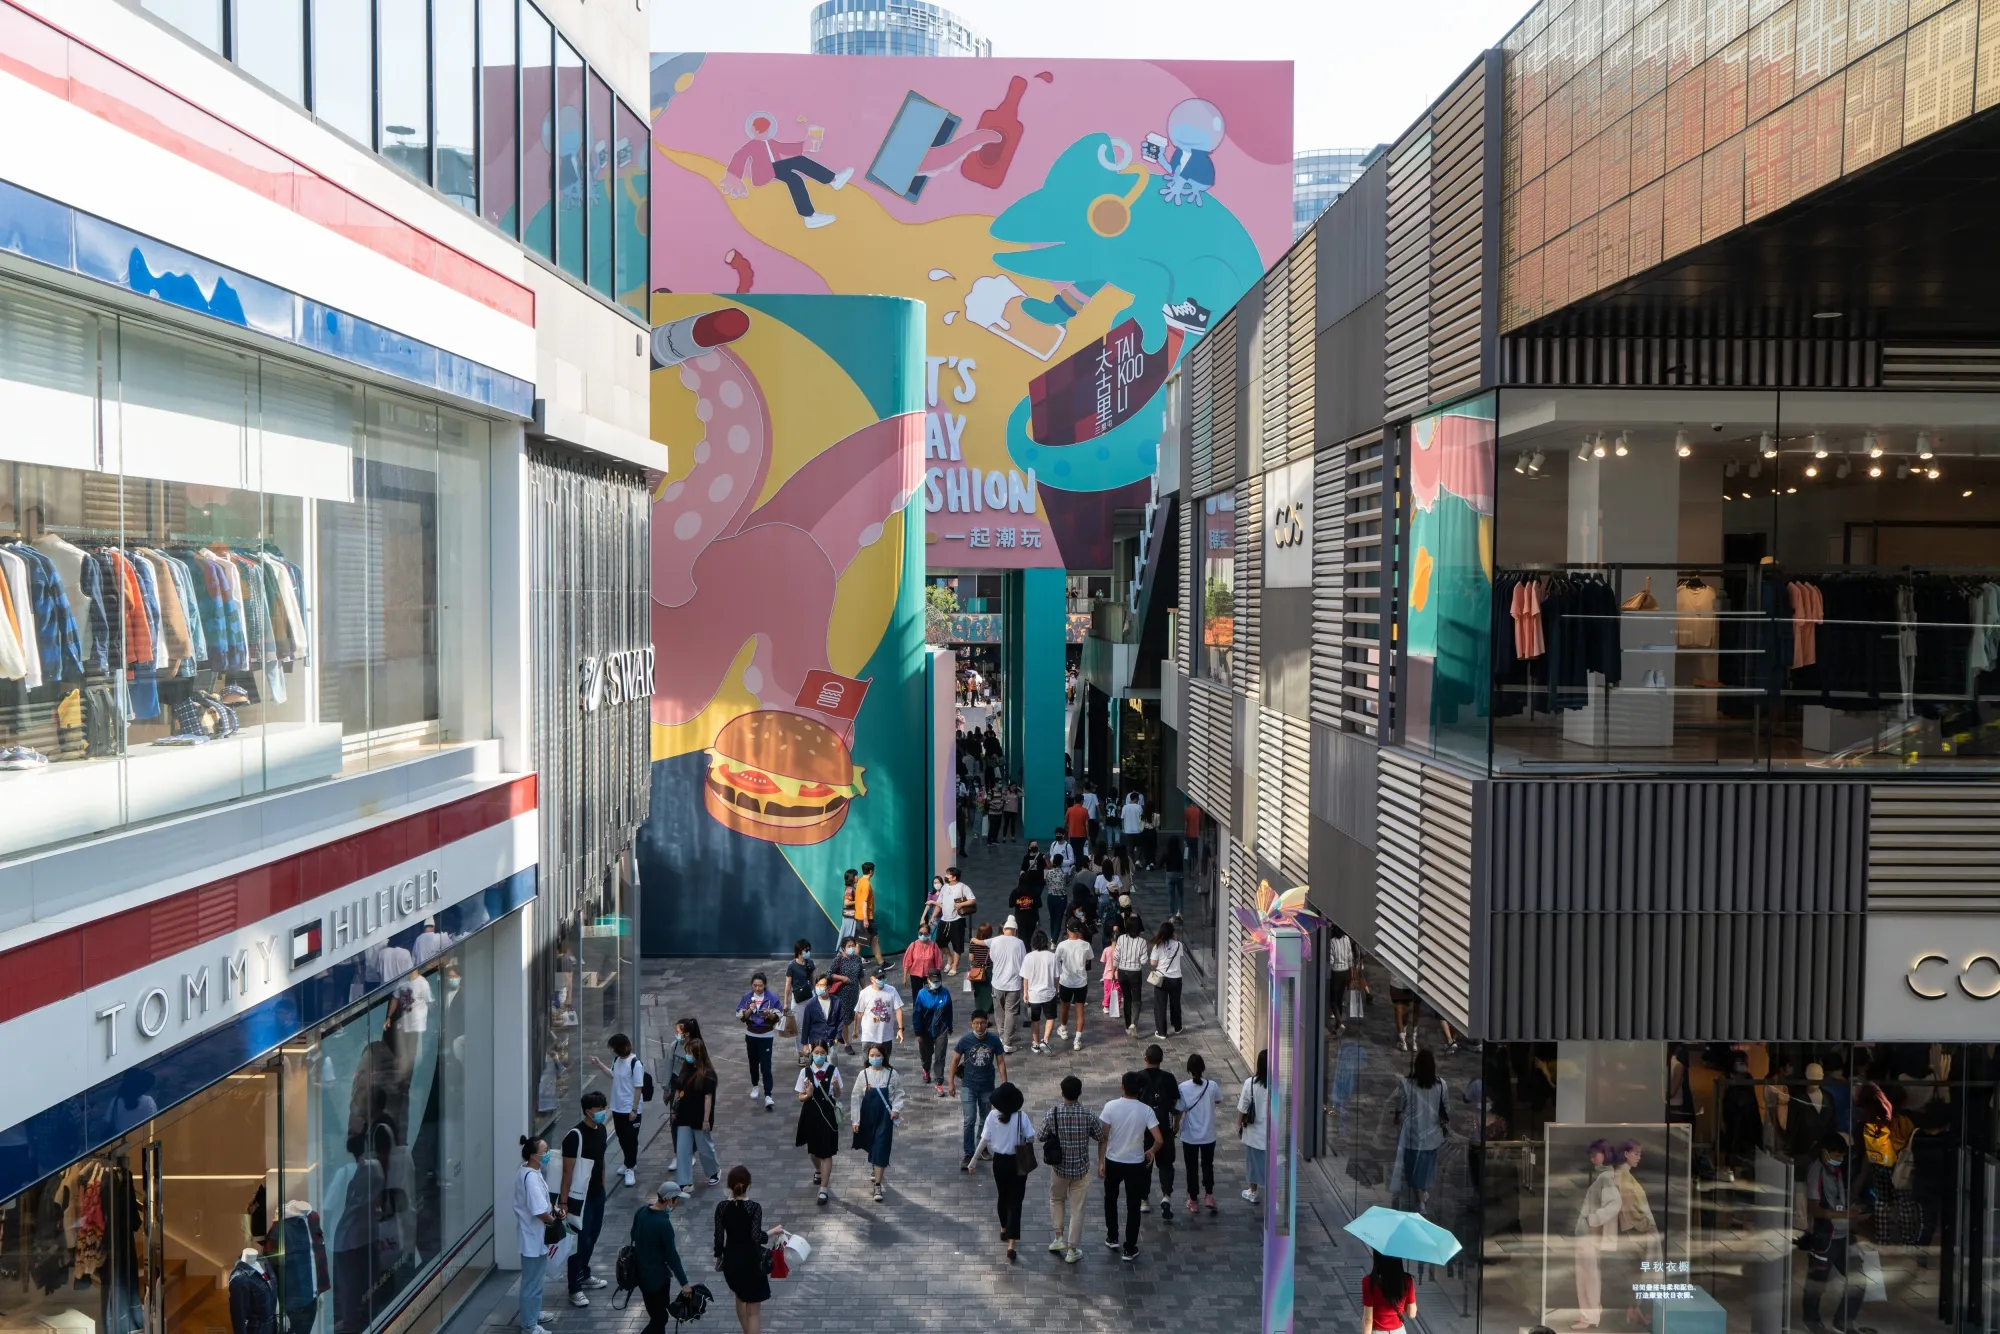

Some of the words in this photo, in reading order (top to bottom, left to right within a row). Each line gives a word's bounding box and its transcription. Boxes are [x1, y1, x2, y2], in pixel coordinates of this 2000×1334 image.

[1115, 332, 1134, 363] TAI
[1117, 353, 1144, 388] KOO
[1095, 348, 1113, 426] 太古里
[1117, 385, 1128, 414] LI
[925, 466, 1036, 514] SHION
[944, 527, 1042, 548] 一起潮玩
[1275, 501, 1304, 549] COS
[606, 647, 655, 706] SWAR
[96, 935, 278, 1058] TOMMY
[331, 869, 441, 950] HILFIGER
